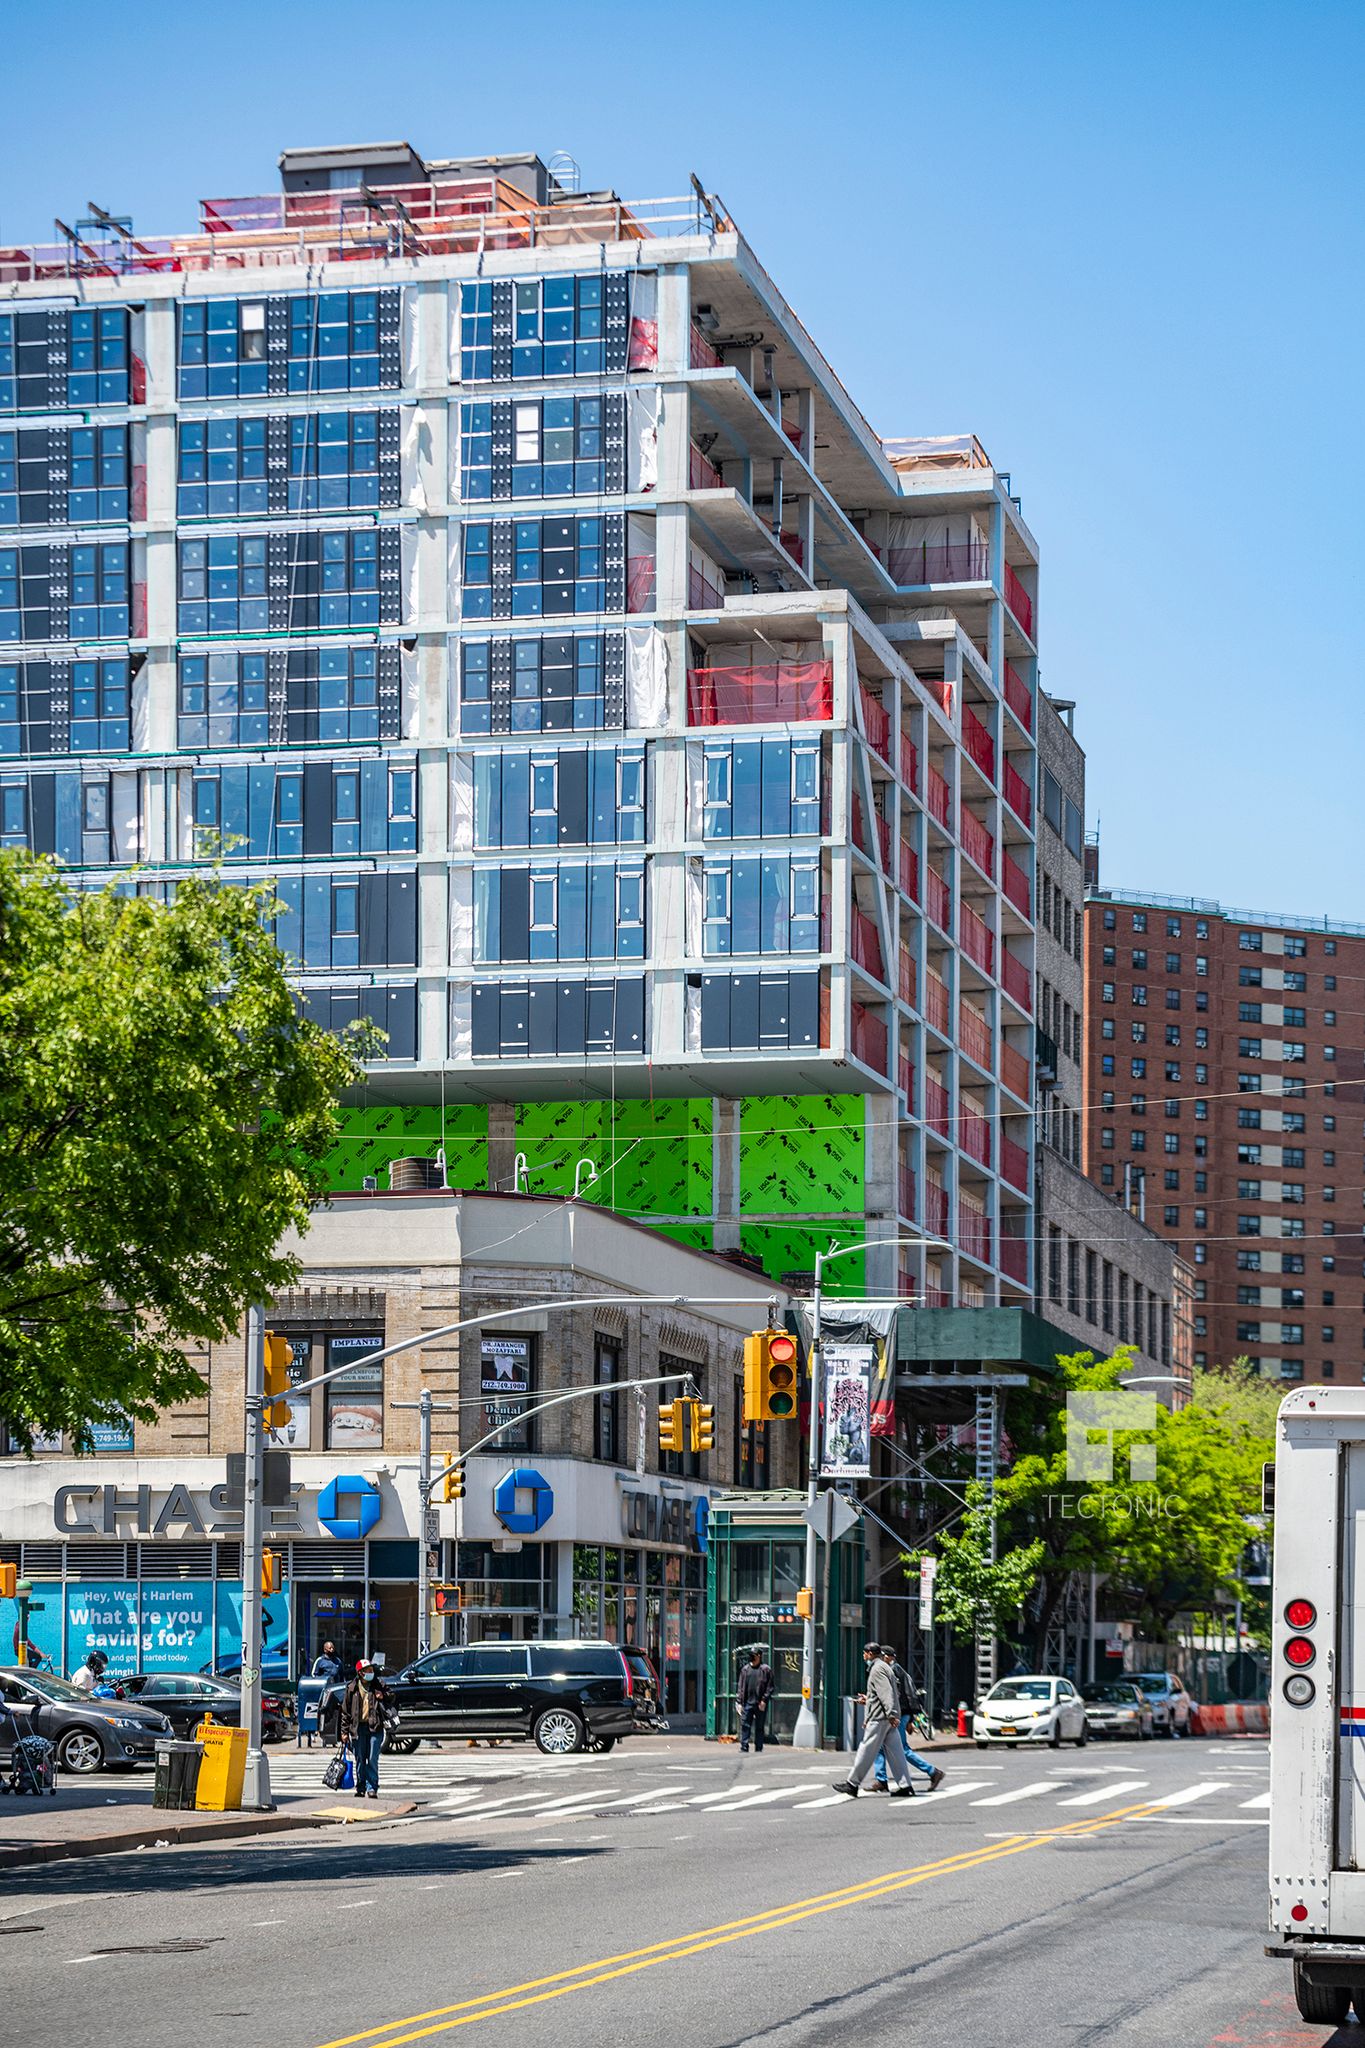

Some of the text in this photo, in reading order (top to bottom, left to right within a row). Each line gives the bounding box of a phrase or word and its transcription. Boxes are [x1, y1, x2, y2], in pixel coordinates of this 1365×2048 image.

[334, 1338, 380, 1347] IMPLANTS
[485, 1405, 521, 1415] Dental
[84, 1591, 193, 1603] Hey, West Harlem
[317, 1598, 333, 1608] CHASE
[730, 1606, 742, 1614] 125
[745, 1606, 769, 1614] Street
[70, 1609, 203, 1628] What are you
[729, 1614, 759, 1623] Subway
[761, 1614, 774, 1622] Sta
[86, 1629, 196, 1650] saving for?
[111, 1654, 190, 1663] and get started today.
